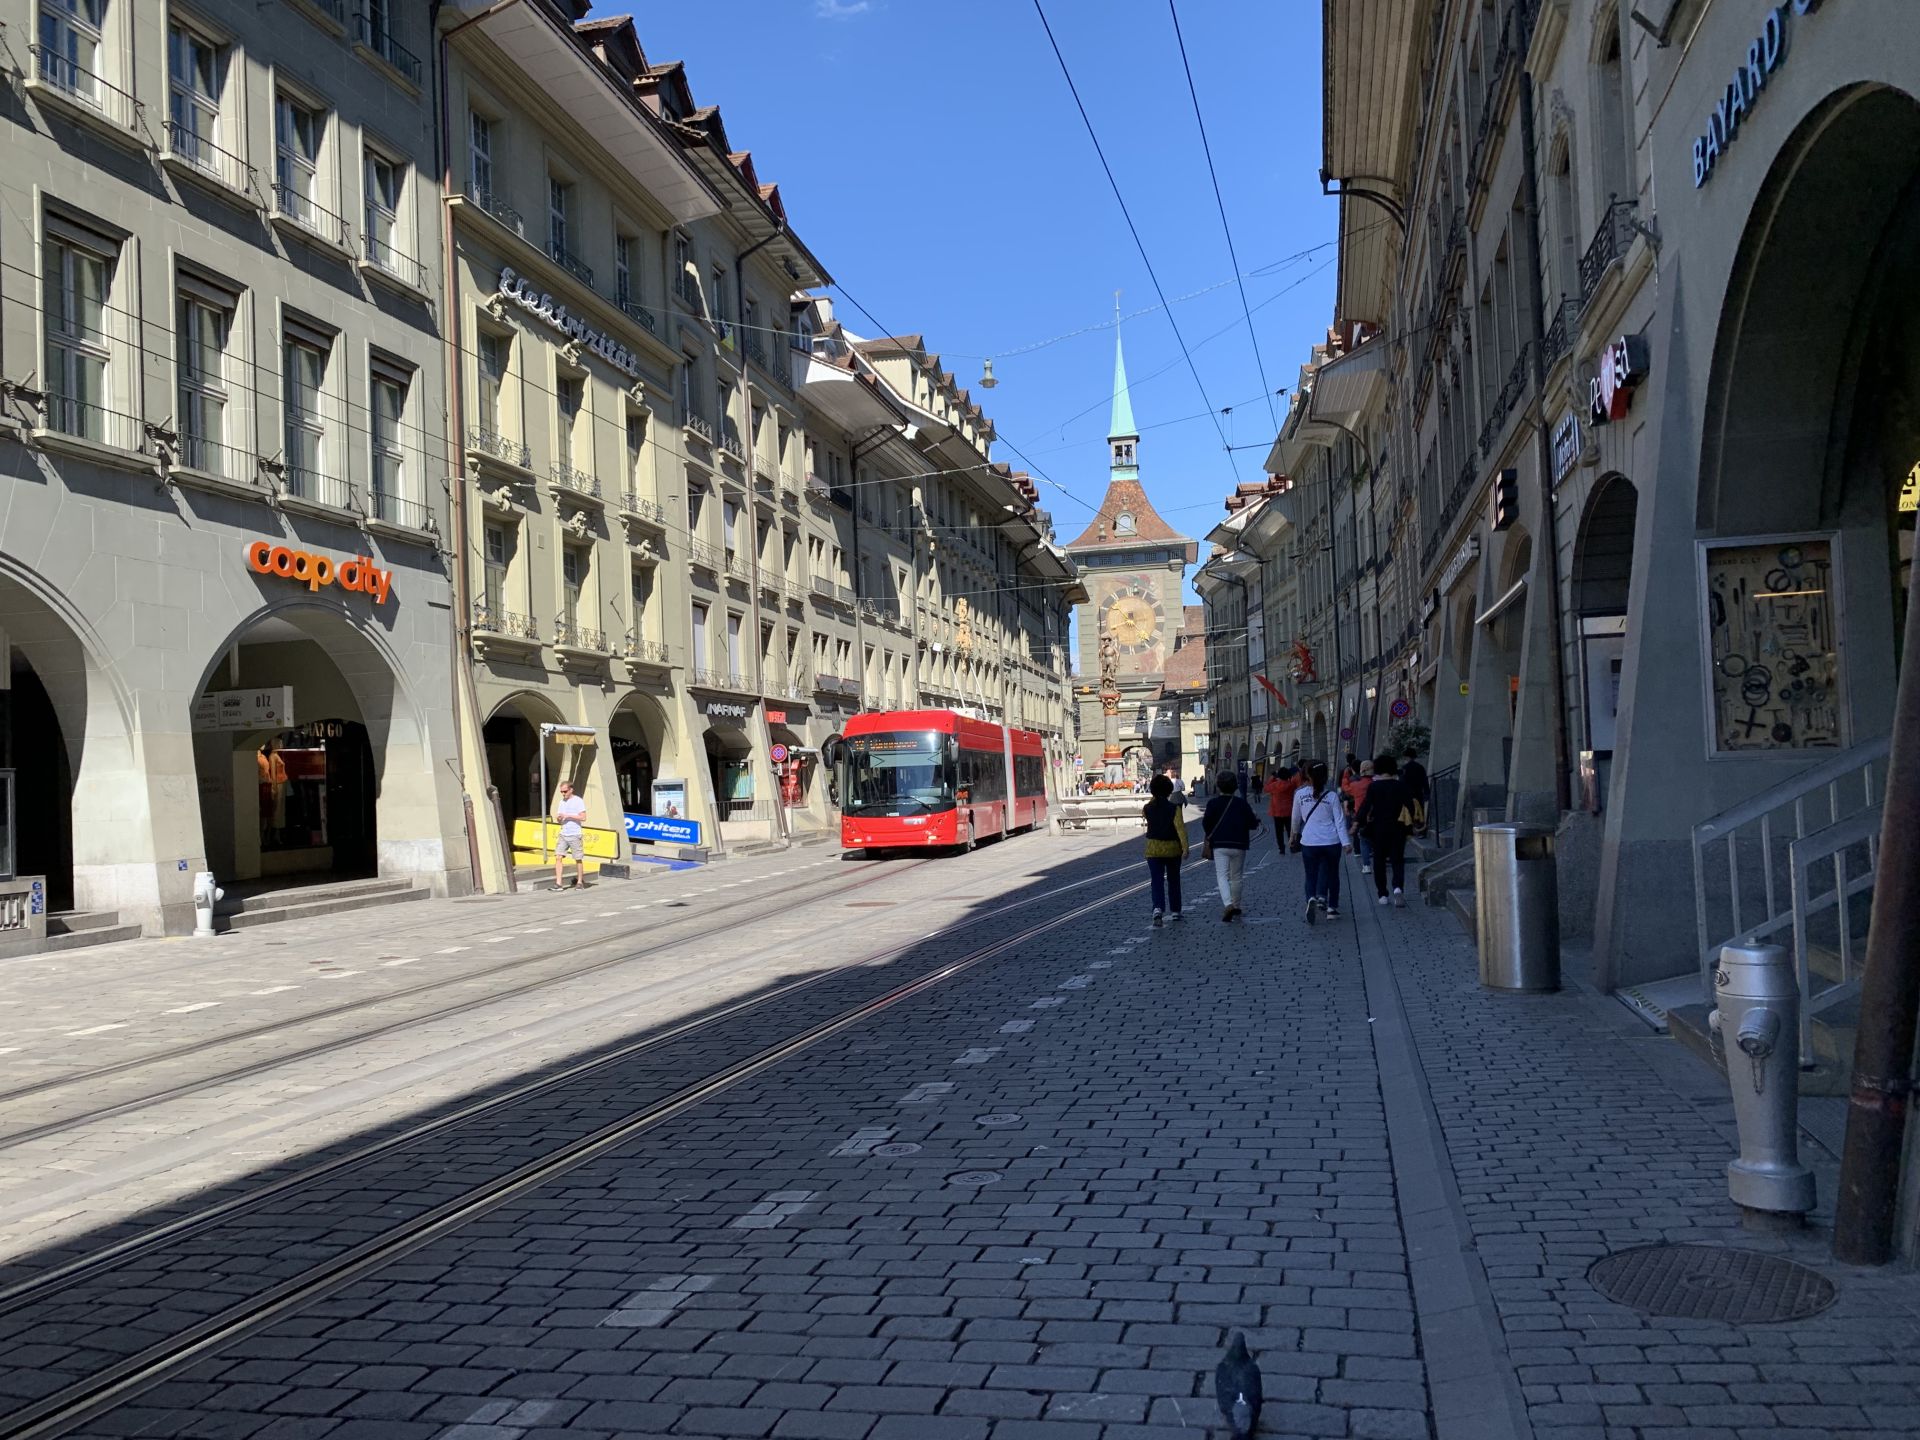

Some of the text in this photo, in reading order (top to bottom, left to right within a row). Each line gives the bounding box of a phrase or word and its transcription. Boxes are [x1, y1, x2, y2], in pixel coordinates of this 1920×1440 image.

[1693, 8, 1780, 188] BAYARD
[498, 266, 640, 377] Elektrizität
[243, 541, 392, 604] coop city
[634, 819, 691, 834] phiten
